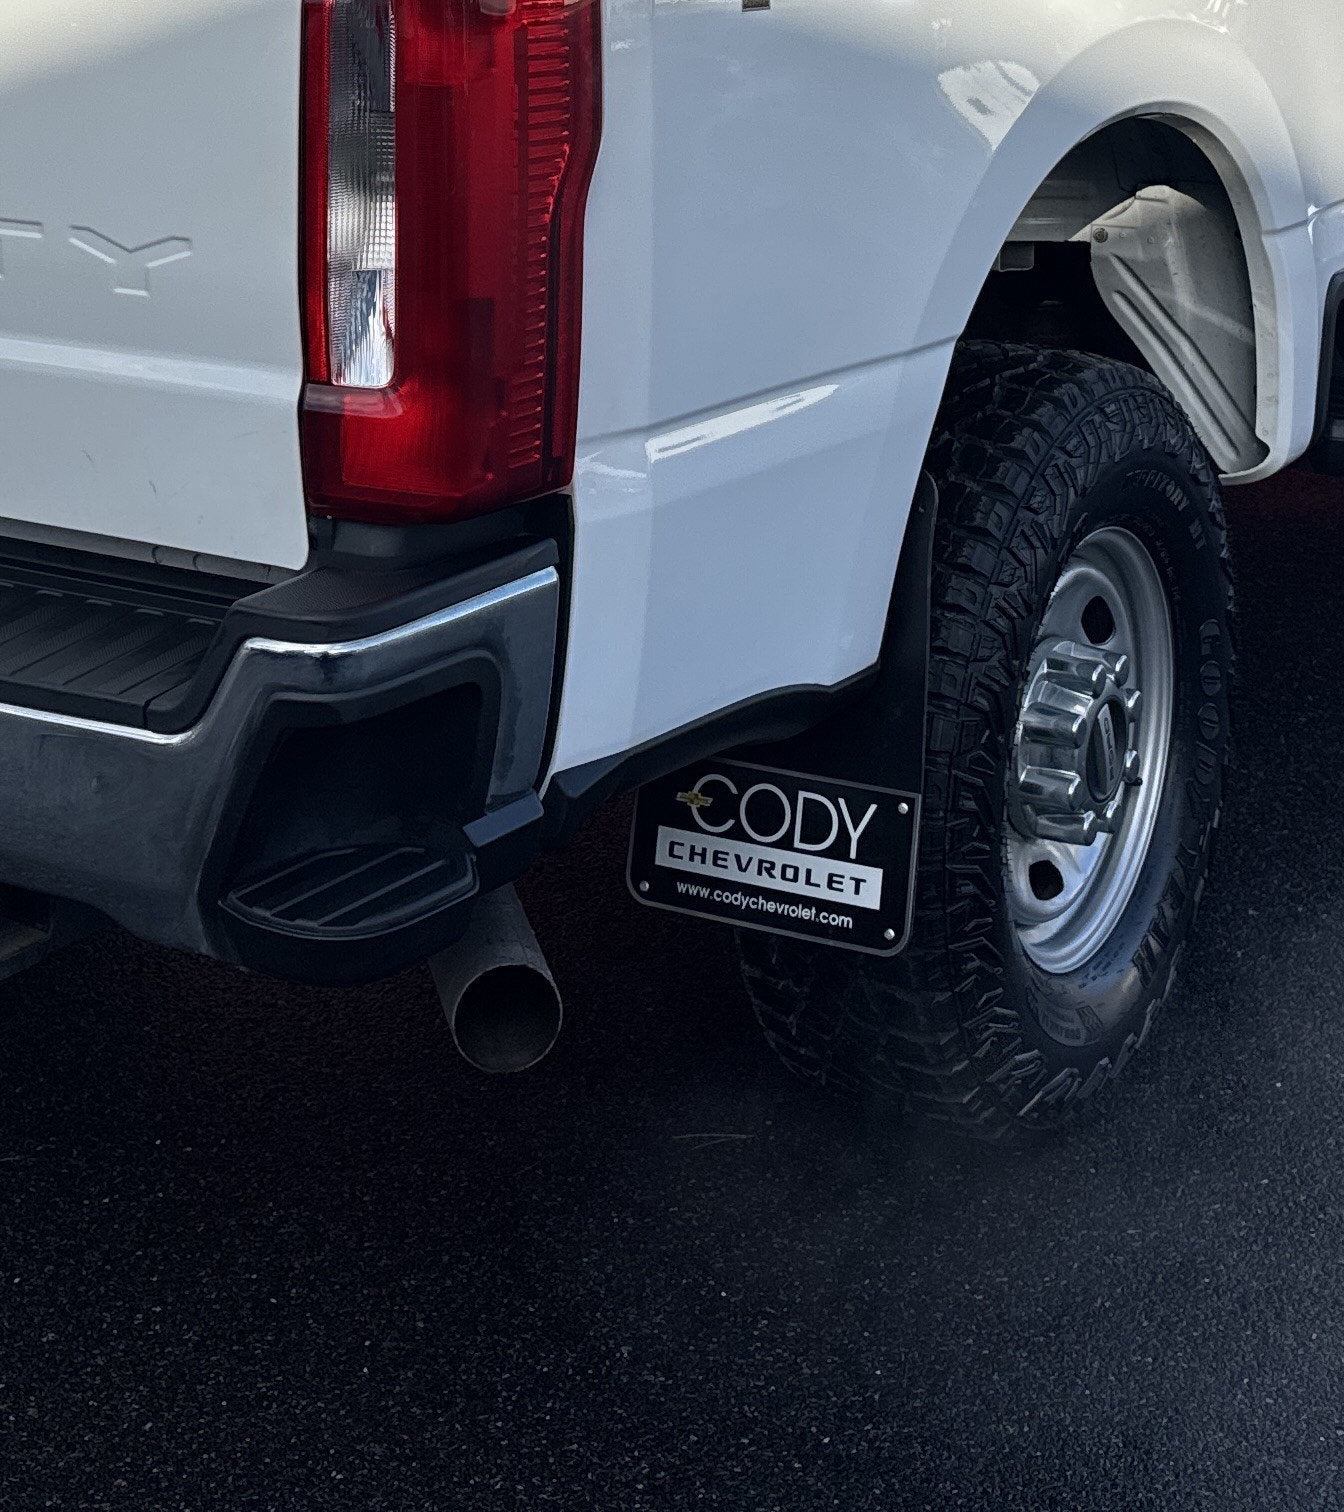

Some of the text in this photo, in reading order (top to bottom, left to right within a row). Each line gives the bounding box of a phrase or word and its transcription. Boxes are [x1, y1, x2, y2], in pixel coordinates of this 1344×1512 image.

[690, 774, 878, 859] CODY
[668, 840, 867, 896] CHEVROLET
[676, 880, 853, 929] www.codychevrolet.com
